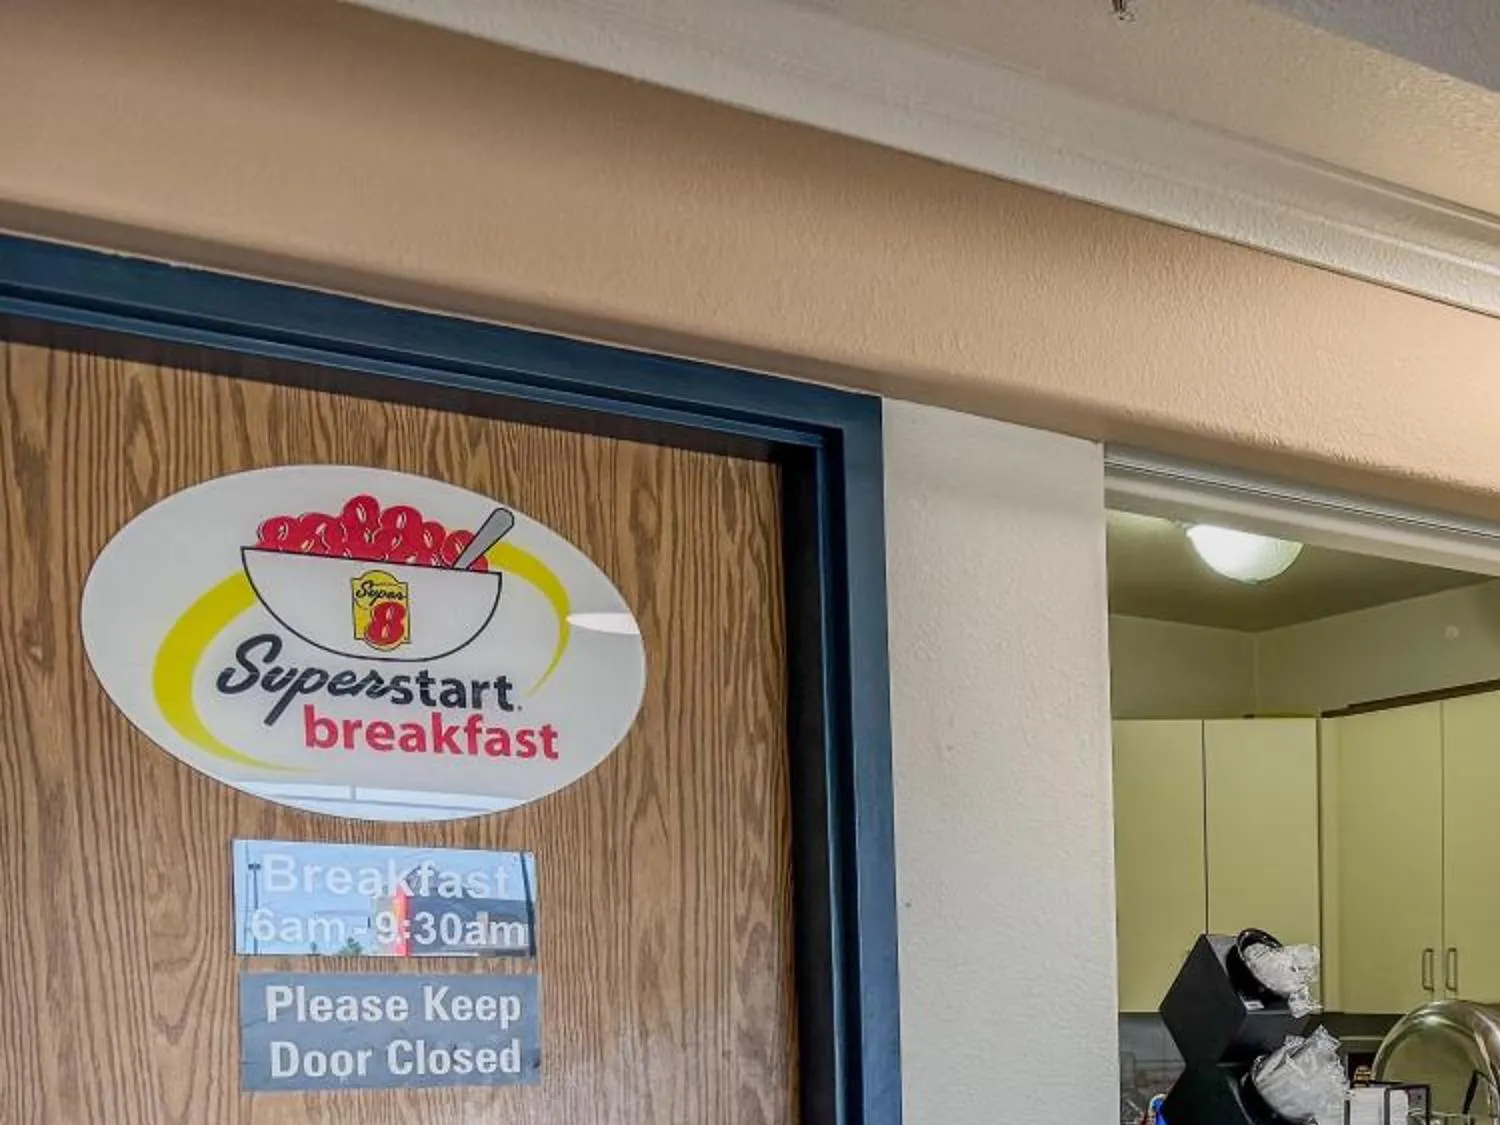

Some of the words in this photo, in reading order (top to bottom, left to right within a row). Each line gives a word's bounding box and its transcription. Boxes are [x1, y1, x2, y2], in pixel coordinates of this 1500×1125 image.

[355, 580, 408, 606] Super
[368, 601, 406, 646] 8
[215, 633, 515, 726] Superstart
[303, 704, 559, 760] breakfast
[263, 853, 511, 899] Breakfast
[265, 985, 409, 1023] Please
[424, 985, 521, 1029] Keep
[270, 1041, 373, 1079] Door
[388, 1040, 522, 1077] Closed
